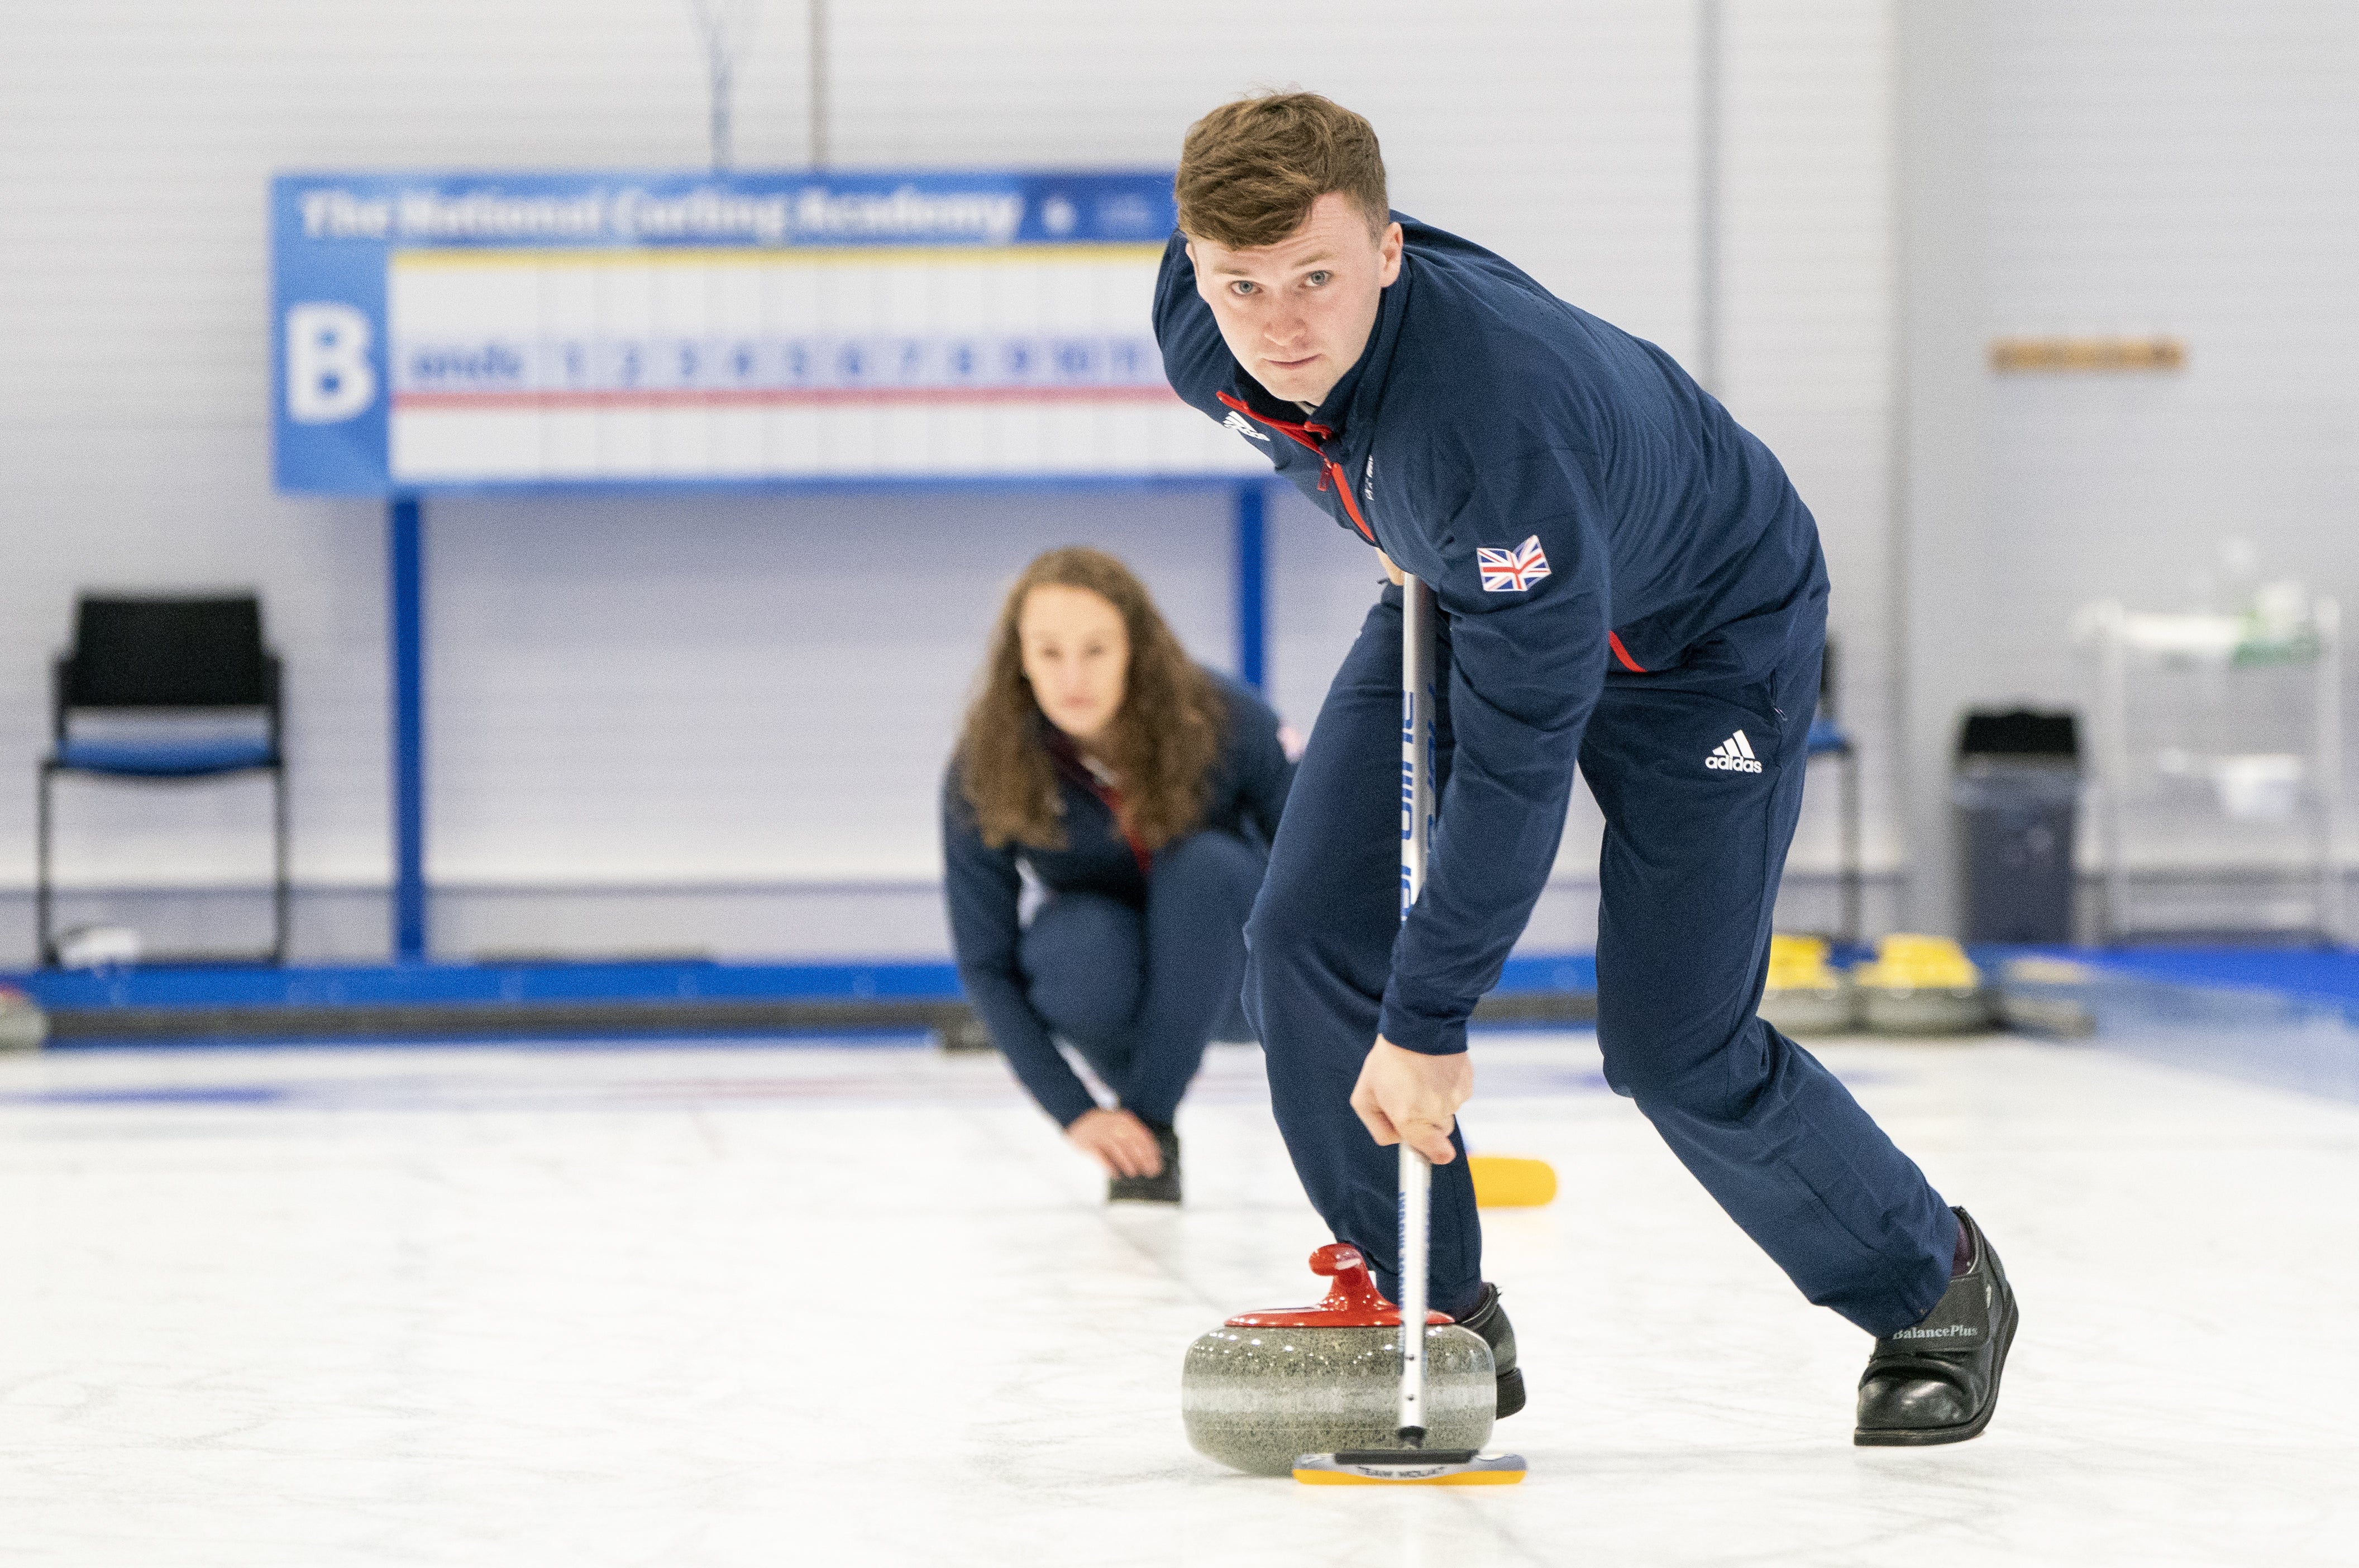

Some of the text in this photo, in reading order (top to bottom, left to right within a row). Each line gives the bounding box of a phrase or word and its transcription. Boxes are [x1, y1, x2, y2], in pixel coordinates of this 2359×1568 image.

[300, 188, 1021, 245] The National Curling Academy
[286, 302, 375, 423] B
[414, 340, 522, 381] ends
[1705, 754, 1763, 773] adidas
